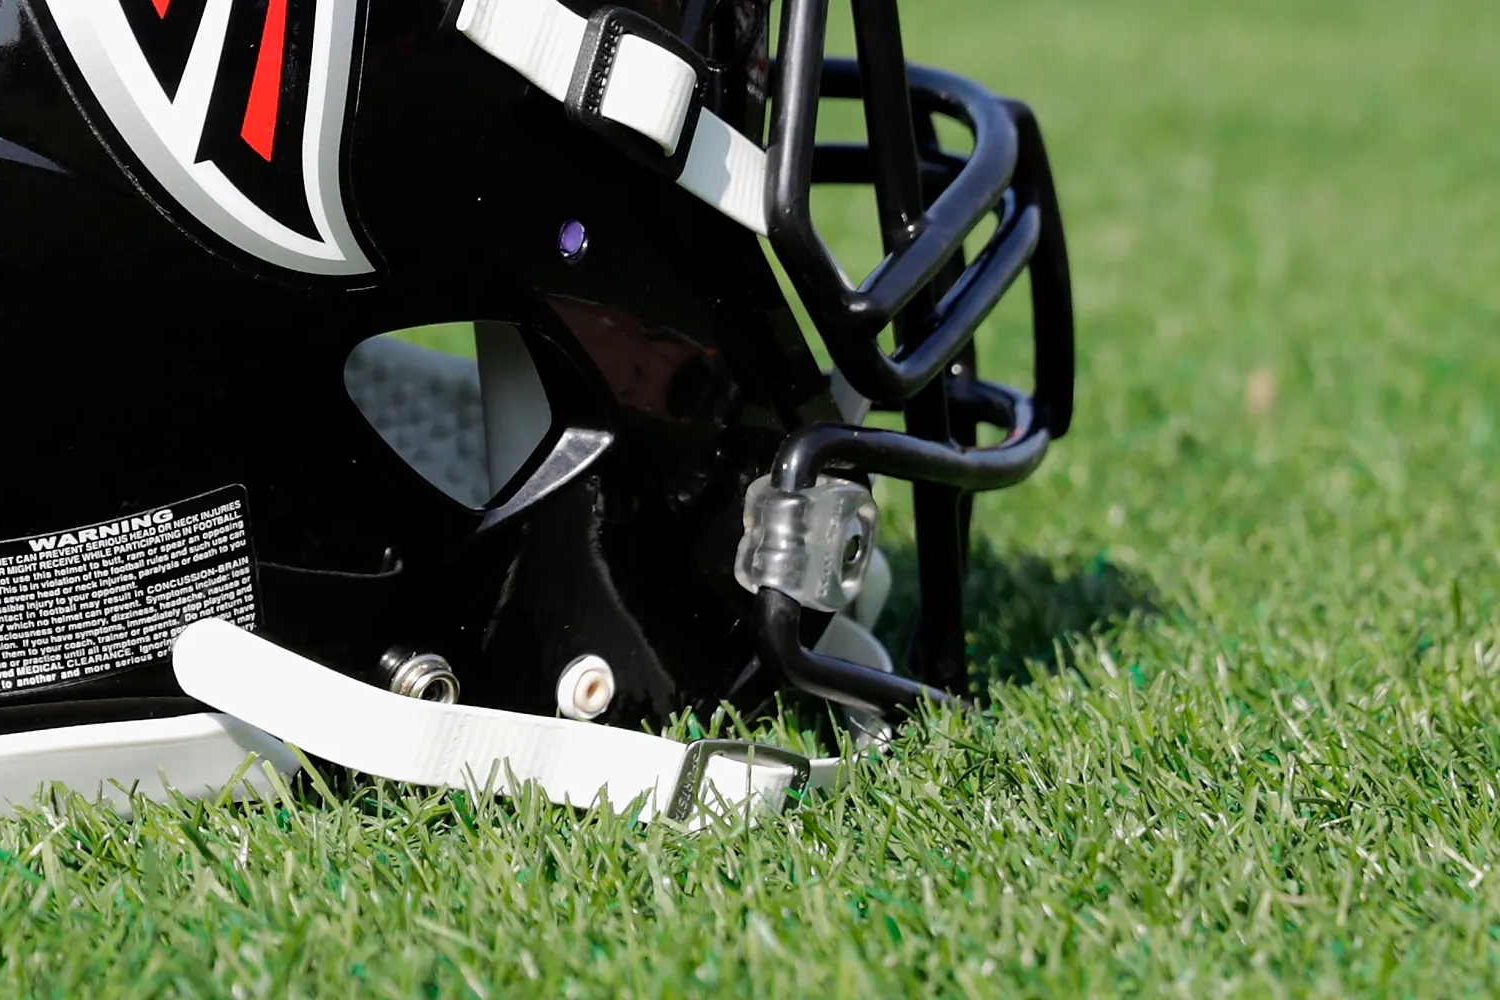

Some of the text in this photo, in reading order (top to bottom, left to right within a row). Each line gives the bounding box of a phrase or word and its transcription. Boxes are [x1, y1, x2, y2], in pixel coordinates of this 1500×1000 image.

[7, 562, 36, 574] MIGHT
[39, 554, 80, 570] RECEIVE
[81, 547, 112, 561] WHILE
[113, 529, 181, 554] PARTICIPATING
[182, 526, 192, 536] IN
[12, 575, 30, 583] use
[33, 571, 51, 580] this
[54, 563, 87, 576] helmet
[89, 562, 99, 570] to
[102, 556, 124, 567] butt,
[126, 551, 145, 561] ram
[147, 547, 157, 555] or
[160, 539, 185, 552] spear
[188, 535, 200, 544] an
[202, 520, 243, 539] opposing
[16, 554, 37, 563] CAN
[39, 545, 83, 560] PREVENT
[85, 534, 128, 551] SERIOUS
[129, 527, 156, 540] HEAD
[157, 522, 171, 533] OR
[173, 514, 199, 528] NECK
[200, 501, 241, 520] INJURIES
[19, 584, 28, 592] is
[29, 582, 39, 590] in
[40, 575, 80, 588] violation
[82, 571, 92, 581] of
[93, 569, 108, 578] the
[110, 559, 144, 574] football
[146, 554, 169, 565] rules
[170, 547, 187, 559] and
[189, 541, 210, 553] such
[212, 536, 227, 546] use
[229, 530, 244, 540] can
[28, 509, 174, 552] WARNING
[3, 593, 35, 603] severe
[37, 587, 60, 598] head
[62, 586, 72, 594] or
[75, 580, 97, 592] neck
[99, 573, 136, 587] injuries,
[138, 560, 179, 579] paralysis
[181, 557, 191, 565] or
[193, 548, 217, 561] death
[219, 545, 228, 553] to
[229, 539, 246, 551] you
[6, 620, 34, 630] which
[51, 612, 83, 624] helmet
[85, 609, 102, 618] can
[104, 599, 141, 616] prevent.
[145, 585, 193, 604] Symptoms
[195, 573, 230, 590] include:
[231, 566, 249, 578] loss
[26, 599, 53, 610] injury
[55, 597, 66, 605] to
[67, 593, 89, 605] your
[91, 581, 137, 598] opponent.
[39, 603, 76, 617] football
[80, 600, 100, 610] may
[103, 592, 131, 604] result
[147, 556, 248, 594] CONCUSSION-BRAIN
[1, 650, 25, 659] them
[40, 645, 62, 655] your
[64, 638, 95, 650] coach,
[97, 631, 128, 643] trainer
[130, 628, 140, 636] or
[142, 619, 180, 635] parents.
[184, 613, 197, 622] Do
[199, 606, 214, 617] not
[216, 598, 242, 612] return
[244, 594, 253, 602] to
[22, 639, 29, 647] If
[30, 638, 48, 647] you
[50, 634, 73, 643] have
[75, 623, 125, 639] symptoms,
[127, 608, 180, 627] immediately
[182, 602, 202, 613] stop
[203, 591, 235, 608] playing
[236, 584, 252, 596] and
[55, 625, 65, 633] or
[68, 618, 108, 630] memory,
[111, 606, 157, 622] dizziness,
[159, 592, 205, 610] headache,
[207, 580, 239, 595] nausea
[241, 576, 250, 584] or
[16, 662, 64, 676] MEDICAL
[66, 648, 134, 667] CLEARANCE.
[237, 612, 256, 624] may
[22, 654, 61, 670] practice
[63, 648, 85, 659] until
[88, 645, 99, 655] all
[102, 635, 151, 654] symptoms
[153, 631, 168, 640] are
[233, 603, 255, 616] have
[1, 680, 12, 689] to
[16, 673, 56, 687] another
[60, 668, 80, 679] and
[84, 664, 110, 674] more
[115, 653, 152, 667] serious
[157, 649, 167, 657] or
